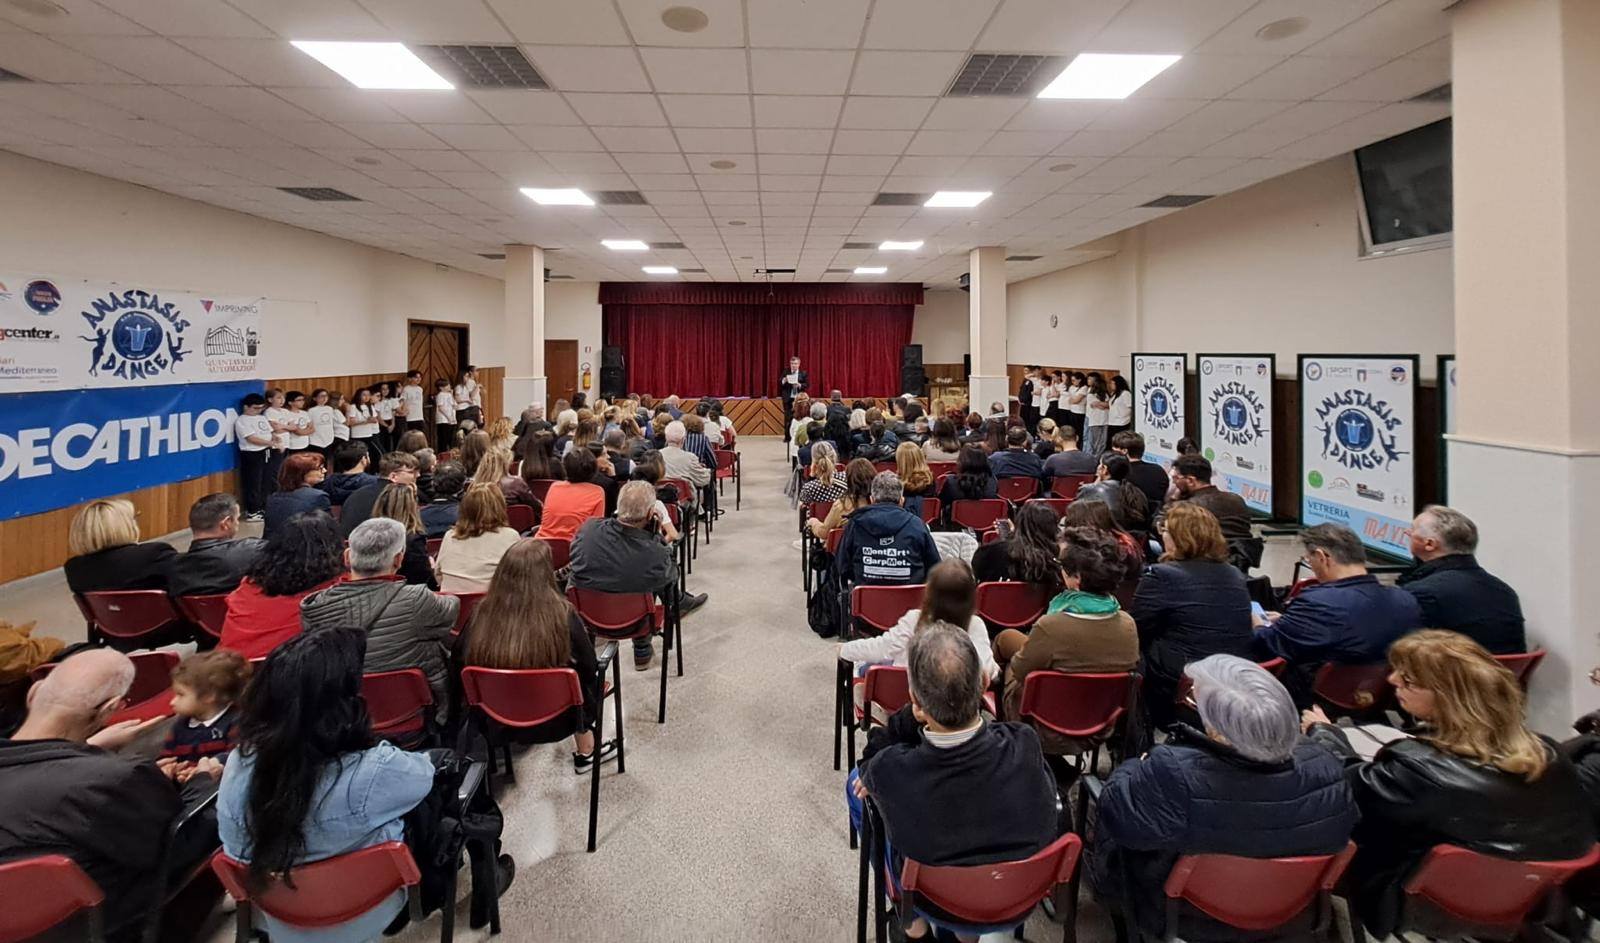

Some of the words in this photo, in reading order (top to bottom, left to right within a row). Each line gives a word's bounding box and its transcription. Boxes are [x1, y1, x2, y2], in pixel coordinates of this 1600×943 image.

[81, 290, 191, 333] ANASTASIS
[1140, 376, 1180, 403] ANASTASIS
[1209, 381, 1264, 414] ANASTASIS
[1315, 389, 1402, 431] ANASTASIS
[1307, 500, 1350, 519] VETRERIA
